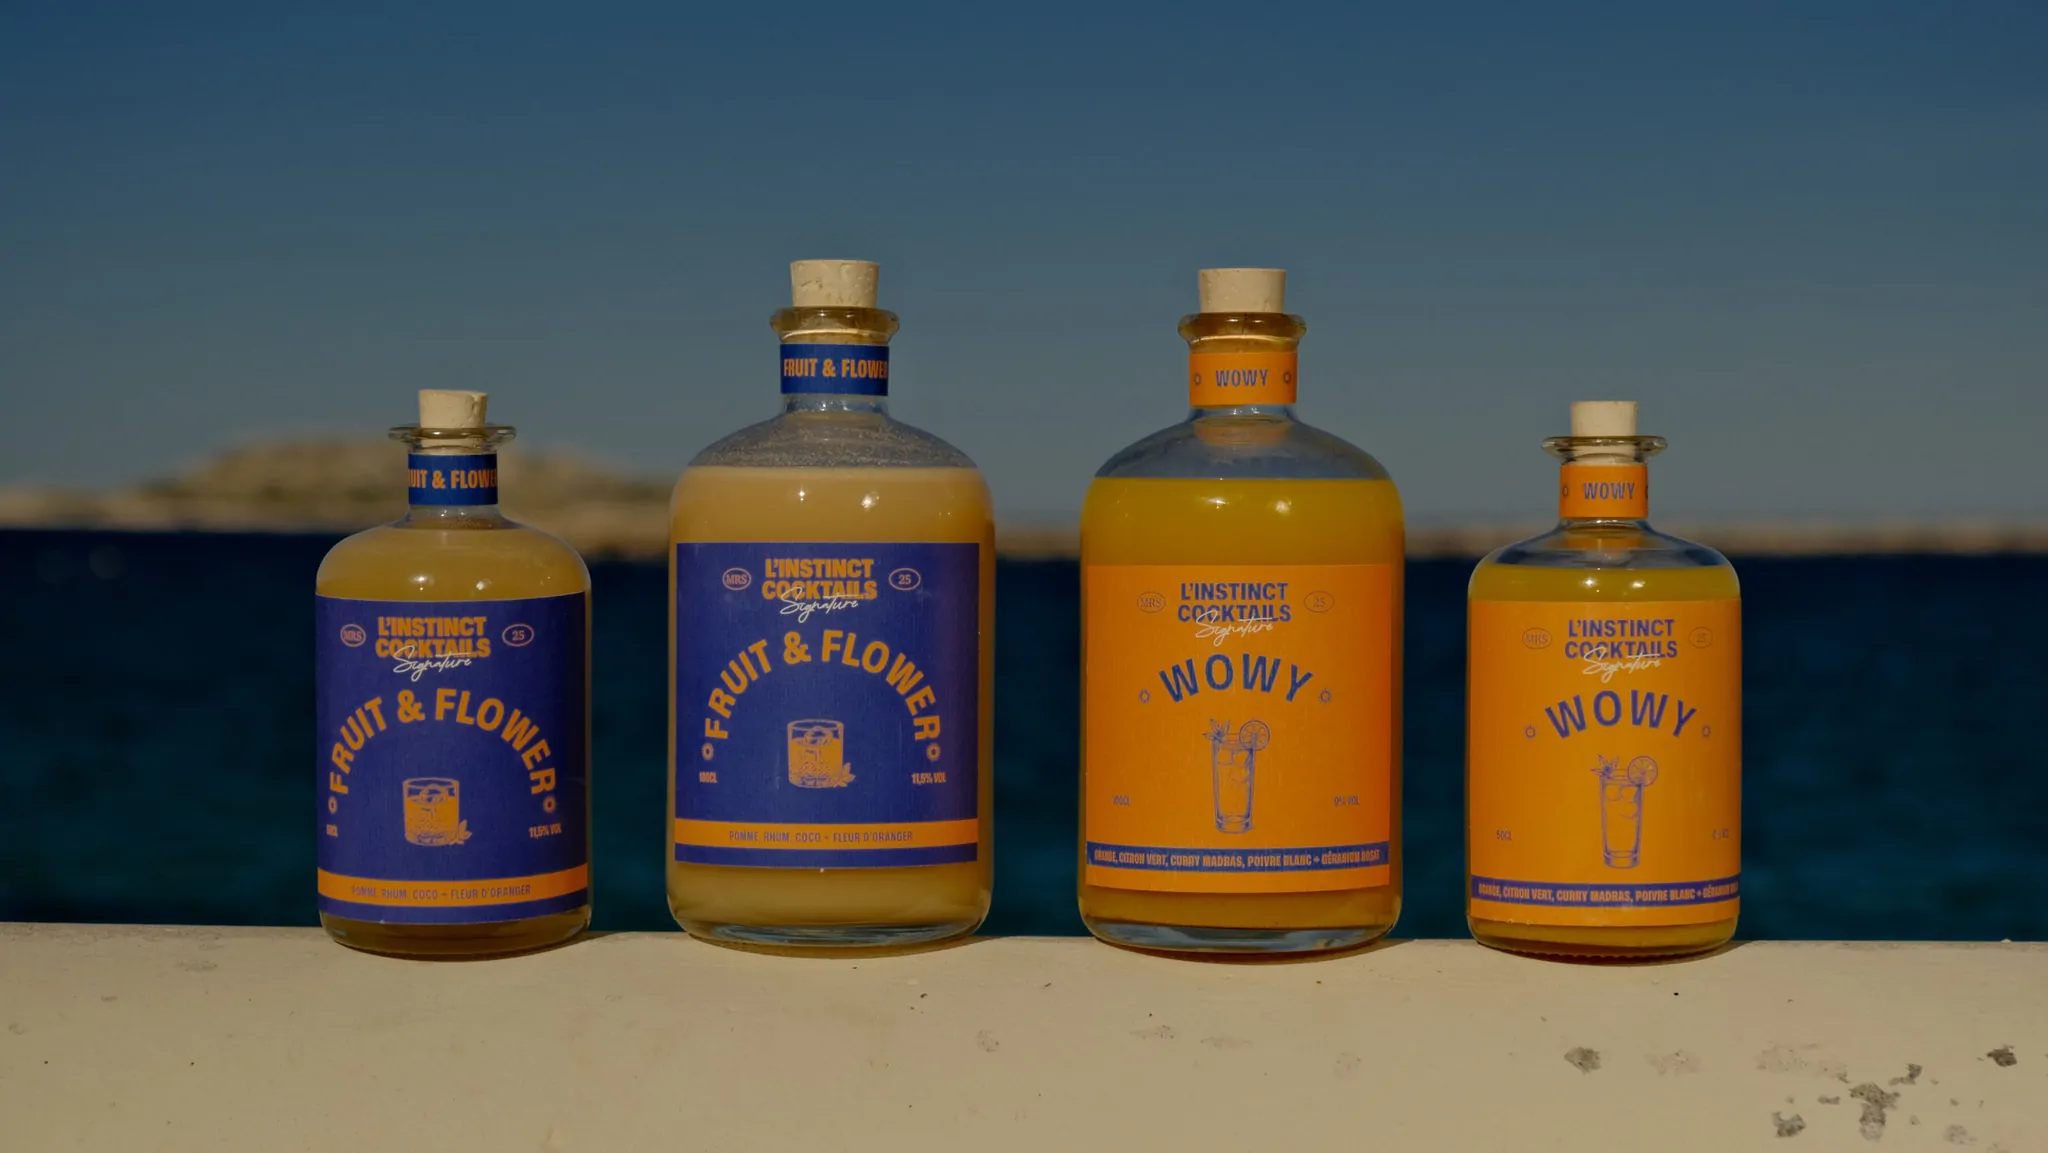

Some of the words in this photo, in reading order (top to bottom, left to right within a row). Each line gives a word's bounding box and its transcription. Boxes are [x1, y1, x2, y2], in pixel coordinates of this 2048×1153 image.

[783, 358, 818, 377] FRUIT
[822, 358, 836, 378] &
[1216, 369, 1268, 387] WOWY
[408, 469, 428, 488] UIT
[432, 470, 447, 489] &
[1583, 482, 1635, 500] WOWY
[765, 559, 874, 578] L'INSTINCT
[726, 574, 747, 585] MRS
[898, 574, 912, 585] 25
[762, 580, 877, 600] COCKTAILS
[1180, 583, 1288, 601] L'INSTINCT
[780, 586, 859, 623] Signature
[1140, 597, 1162, 607] MRS
[1177, 604, 1292, 622] COCKTAILS
[378, 616, 487, 637] L'INSTINCT
[511, 630, 525, 641] 25
[1195, 609, 1273, 646] Signature
[1568, 619, 1675, 638] L'INSTINCT
[375, 638, 492, 658] COCKTAILS
[1564, 641, 1678, 659] COCKTAILS
[392, 645, 472, 682] Signature
[1582, 646, 1661, 684] Signature
[704, 639, 771, 740] FRUIT
[783, 630, 812, 665] &
[821, 629, 941, 741] FLOWER
[1158, 653, 1314, 703] WOWY
[1544, 689, 1698, 739] WOWY
[329, 697, 388, 796] FRUIT
[397, 689, 426, 723] &
[434, 688, 557, 796] FLOWER
[795, 832, 821, 843] COCO
[833, 831, 860, 844] FLEUR
[863, 830, 913, 843] D'ORANGER
[1119, 852, 1145, 865] CITRON
[1146, 853, 1169, 867] VERT,
[1170, 855, 1200, 867] CURRY
[1202, 855, 1245, 868] MADRAS,
[1247, 855, 1281, 867] POIVRE
[1283, 854, 1312, 866] BLANC
[413, 889, 438, 900] COCO
[451, 888, 478, 900] FLEUR
[1503, 886, 1530, 899] CITRON
[1531, 888, 1555, 902] VERT,
[1556, 890, 1588, 902] CURRY
[1590, 890, 1634, 903] MADRAS,
[1635, 889, 1669, 902] POIVRE
[1670, 887, 1696, 900] BLANC
